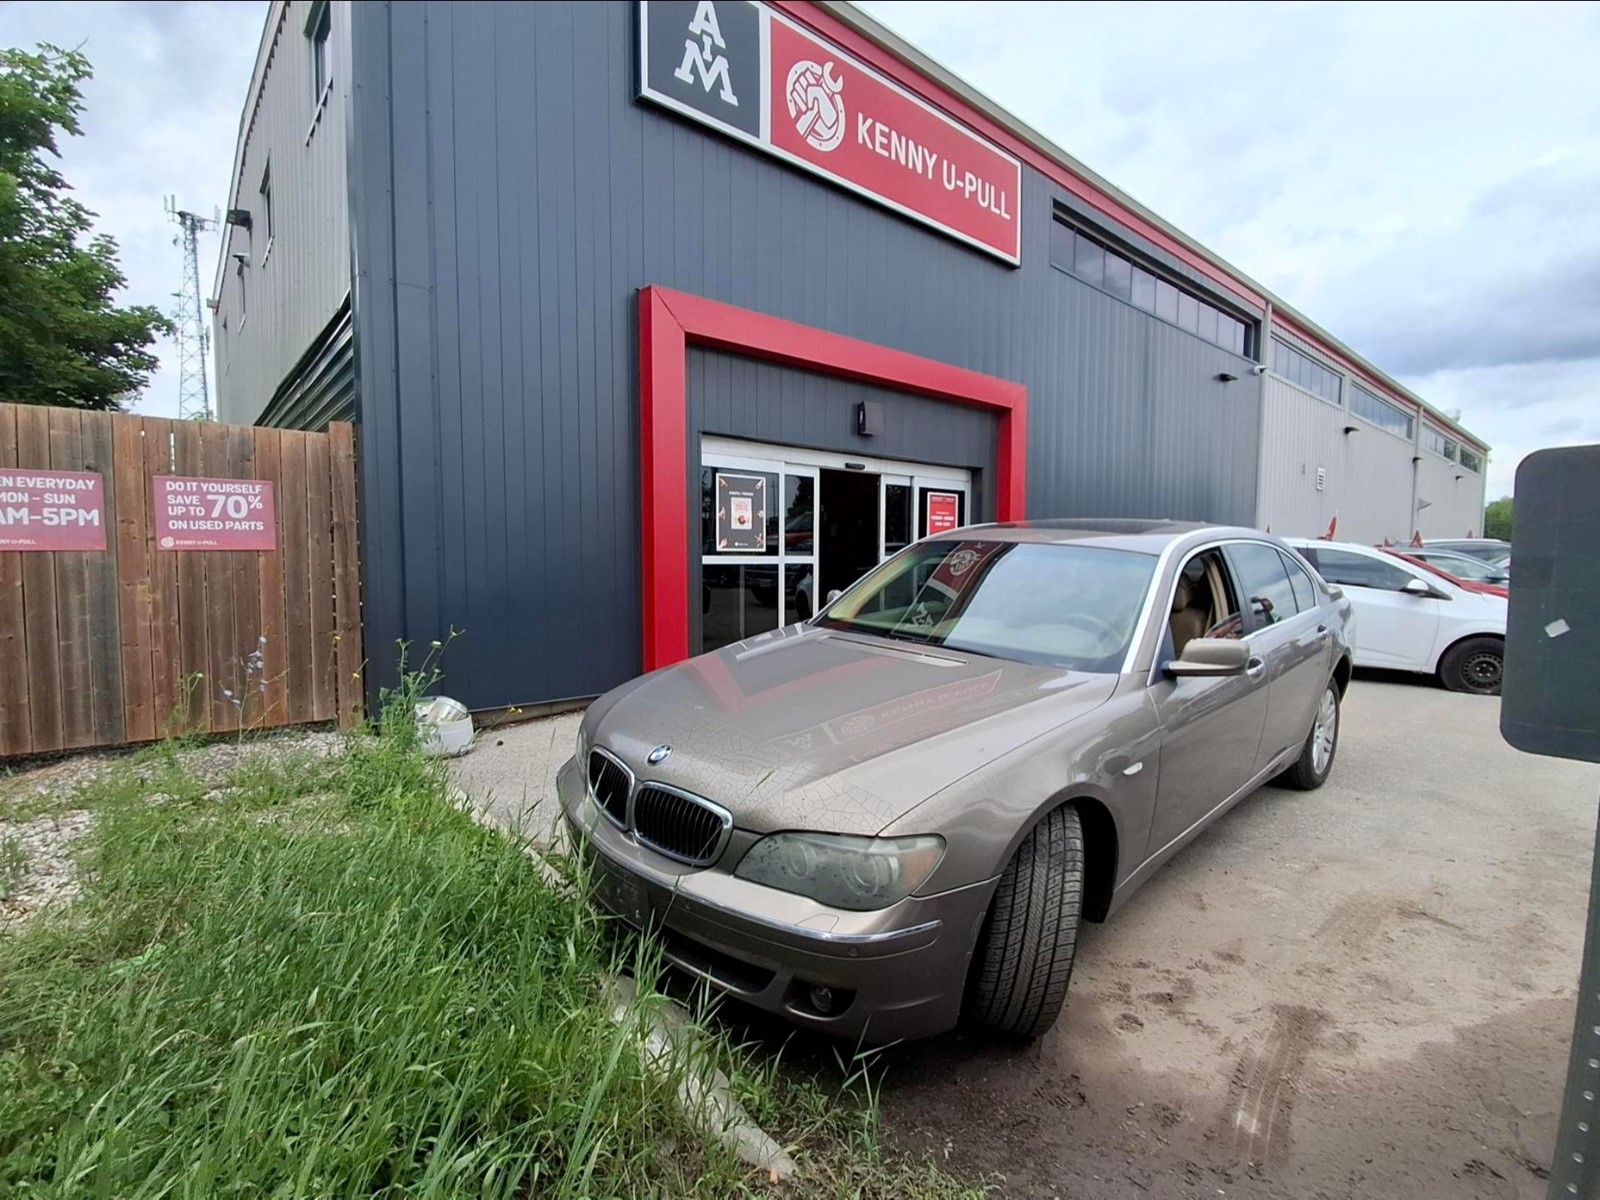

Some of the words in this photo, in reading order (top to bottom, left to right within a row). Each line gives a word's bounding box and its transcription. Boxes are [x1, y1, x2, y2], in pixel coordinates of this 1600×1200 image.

[857, 112, 938, 180] KENNY
[942, 159, 1011, 220] U-PULL
[0, 476, 13, 487] N
[16, 476, 95, 490] EVERYDAY
[166, 481, 185, 491] DO
[187, 481, 198, 491] IT
[200, 482, 262, 494] YOURSELF
[43, 493, 76, 504] SUN
[167, 494, 201, 505] SAVE
[168, 506, 186, 516] UP
[188, 506, 205, 517] TO
[206, 494, 263, 519] 70%
[168, 520, 188, 530] ON
[190, 521, 223, 530] USED
[225, 521, 264, 531] PARTS
